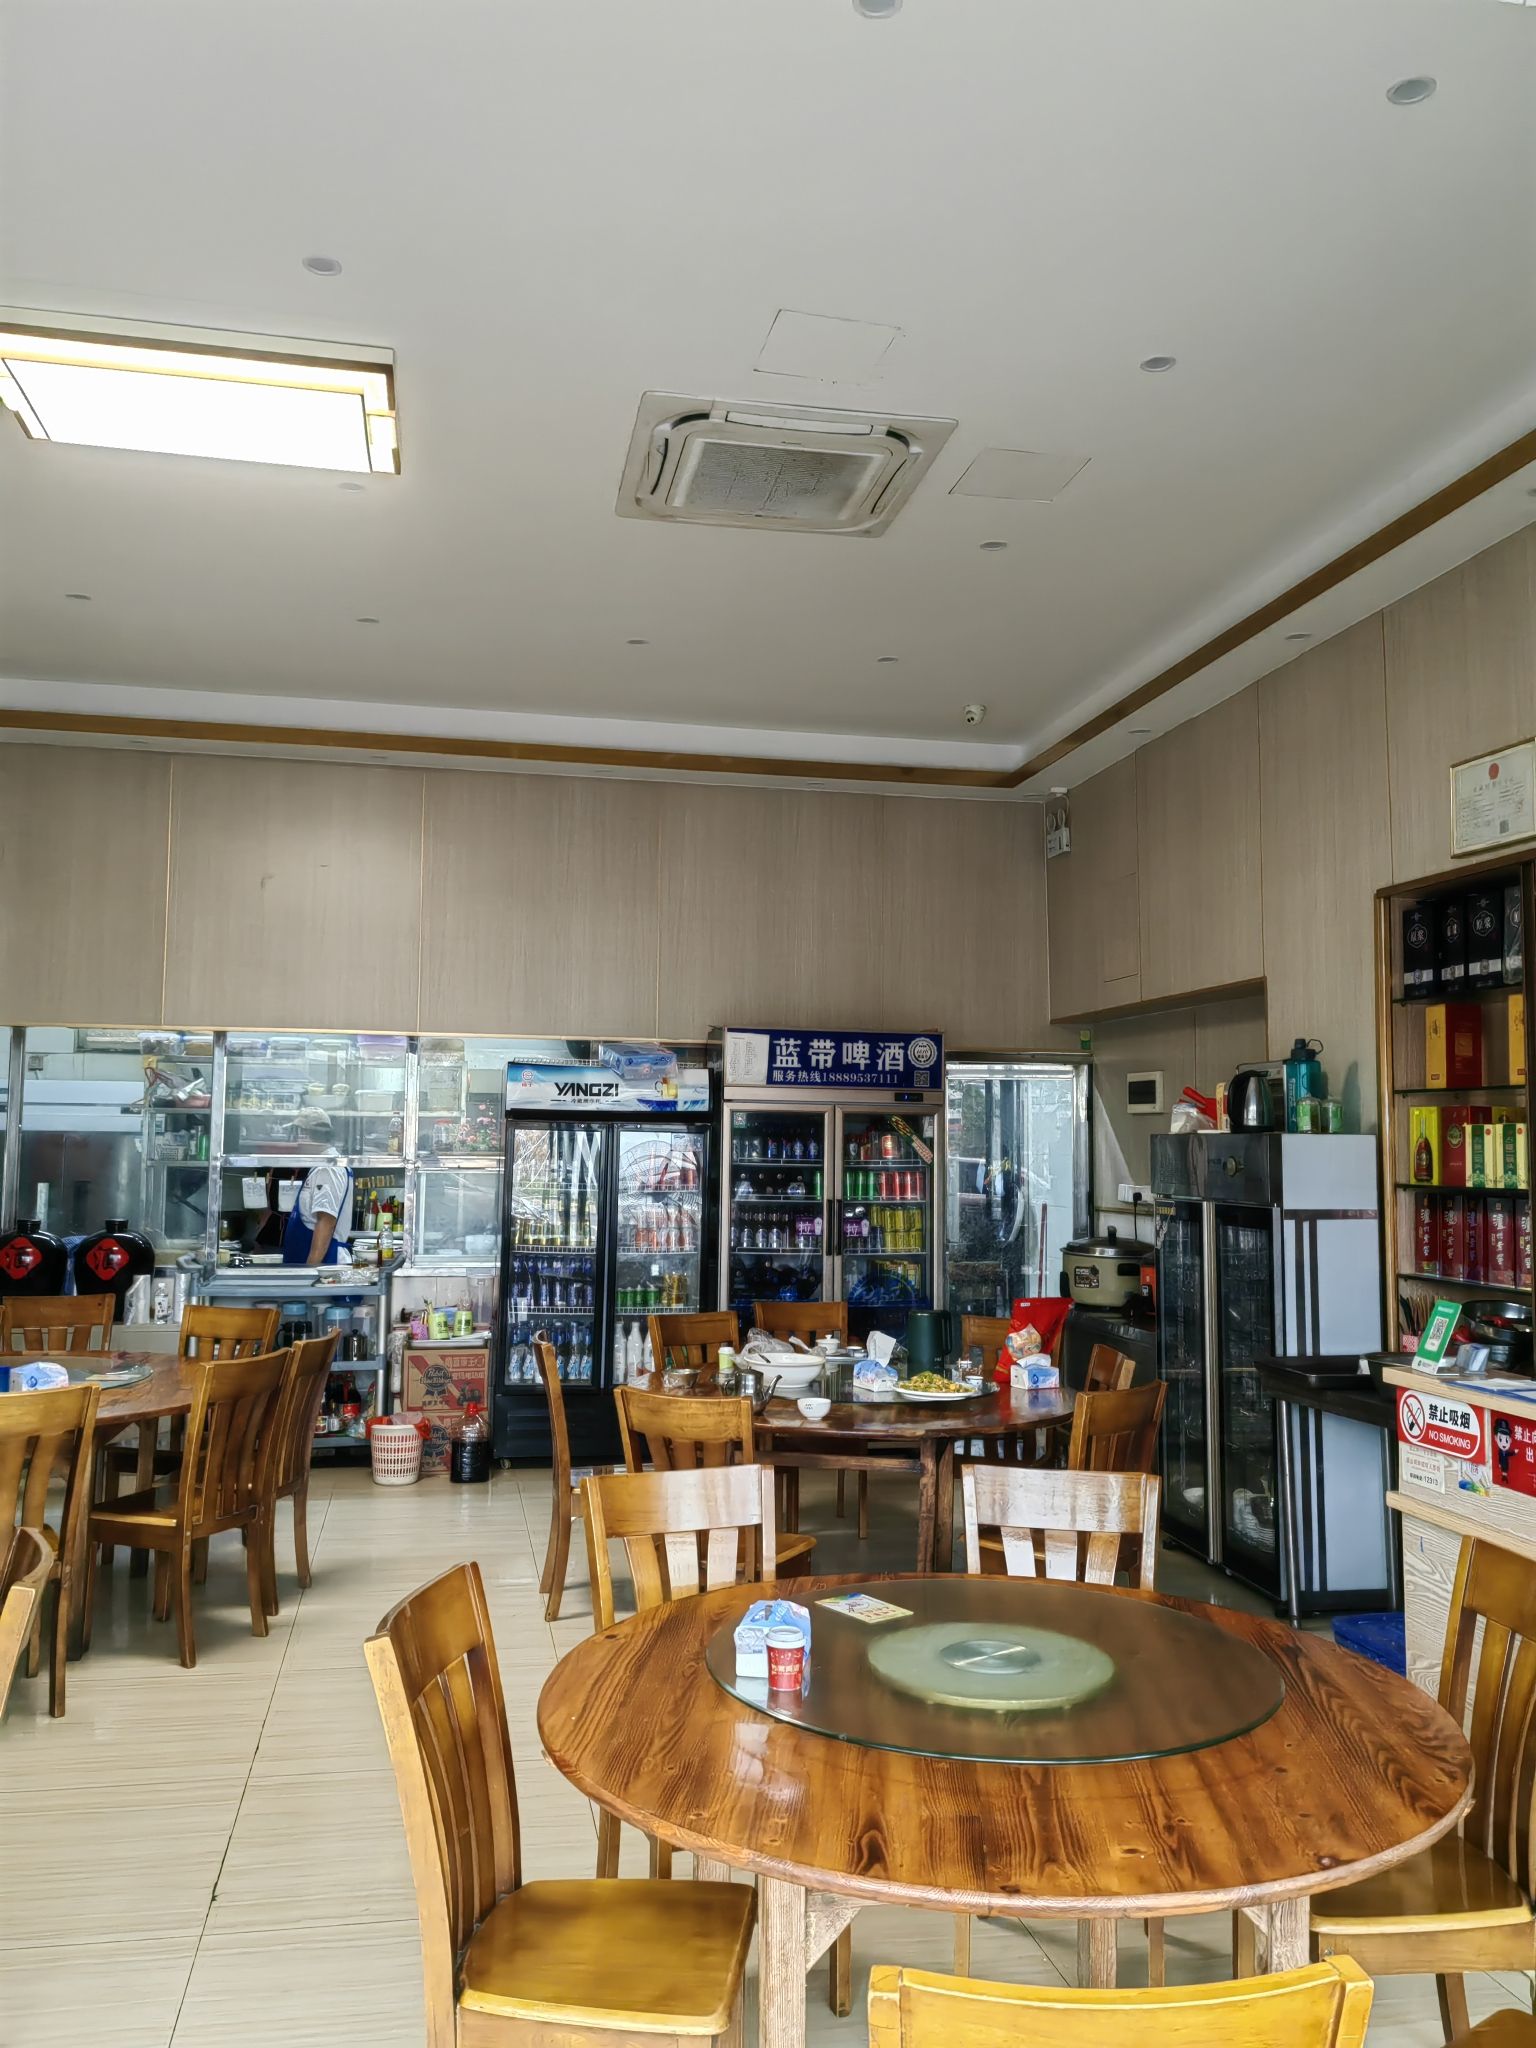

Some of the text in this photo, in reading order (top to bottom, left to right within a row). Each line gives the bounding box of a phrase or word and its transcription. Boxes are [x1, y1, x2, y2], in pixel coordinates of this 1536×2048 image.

[772, 1037, 905, 1072] 蓝带啤酒
[772, 1070, 899, 1084] 服务热线18889537111
[554, 1082, 619, 1097] YANGZI
[798, 1221, 812, 1236] 拉
[846, 1223, 859, 1237] 拉
[1428, 1404, 1471, 1430] 禁止吸烟
[1428, 1430, 1471, 1450] NO SMOKING
[1526, 1447, 1534, 1463] 出
